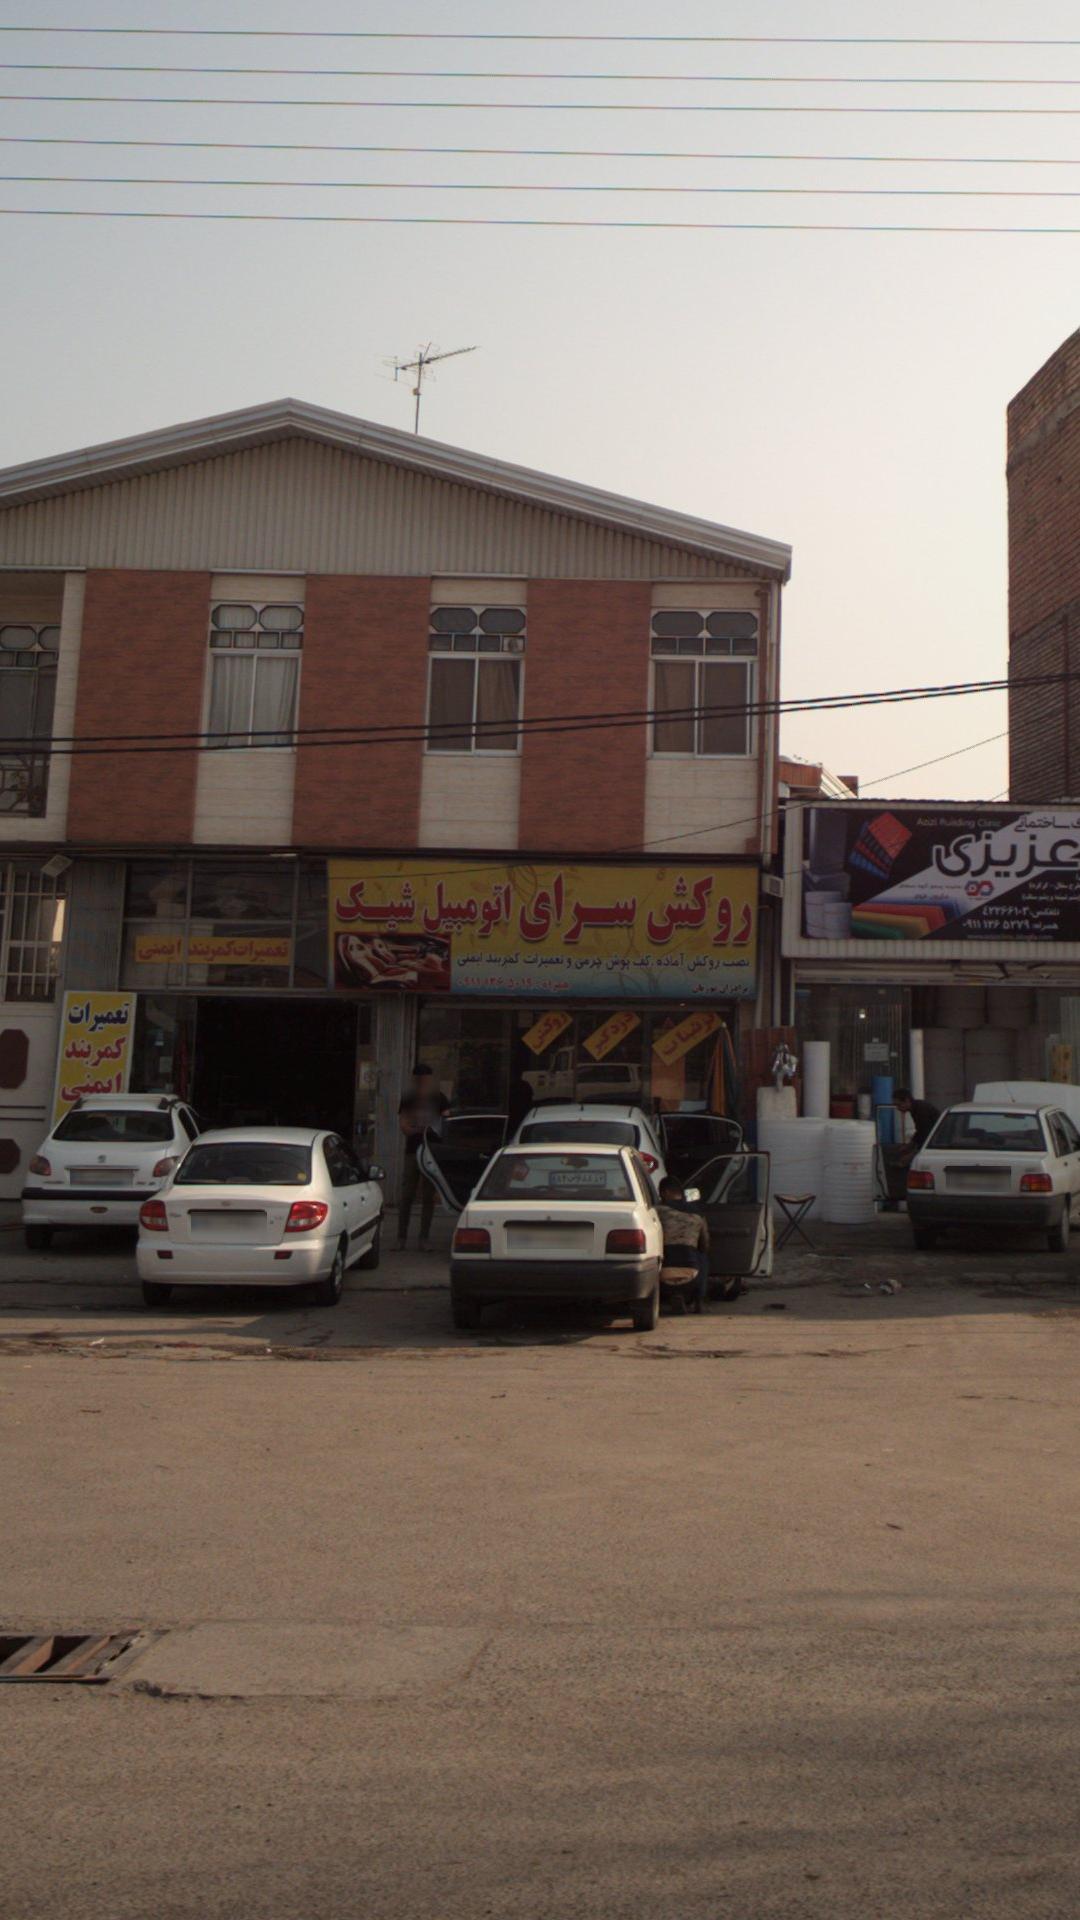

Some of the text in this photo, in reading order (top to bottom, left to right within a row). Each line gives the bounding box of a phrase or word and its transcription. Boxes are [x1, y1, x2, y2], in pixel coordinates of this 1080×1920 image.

[935, 833, 1078, 878] عزیزی
[335, 872, 752, 944] روکش سرای اتومبیل شیک
[138, 938, 181, 960] ایمنی
[233, 941, 288, 962] تعمیرات
[457, 952, 482, 966] ایمنی
[486, 952, 519, 967] کمربند
[523, 953, 563, 968] تعمیرات
[688, 955, 720, 971] روکش
[68, 1001, 129, 1032] تعمیرات
[65, 1037, 126, 1067] کمربند
[61, 1072, 122, 1101] ایمنی
